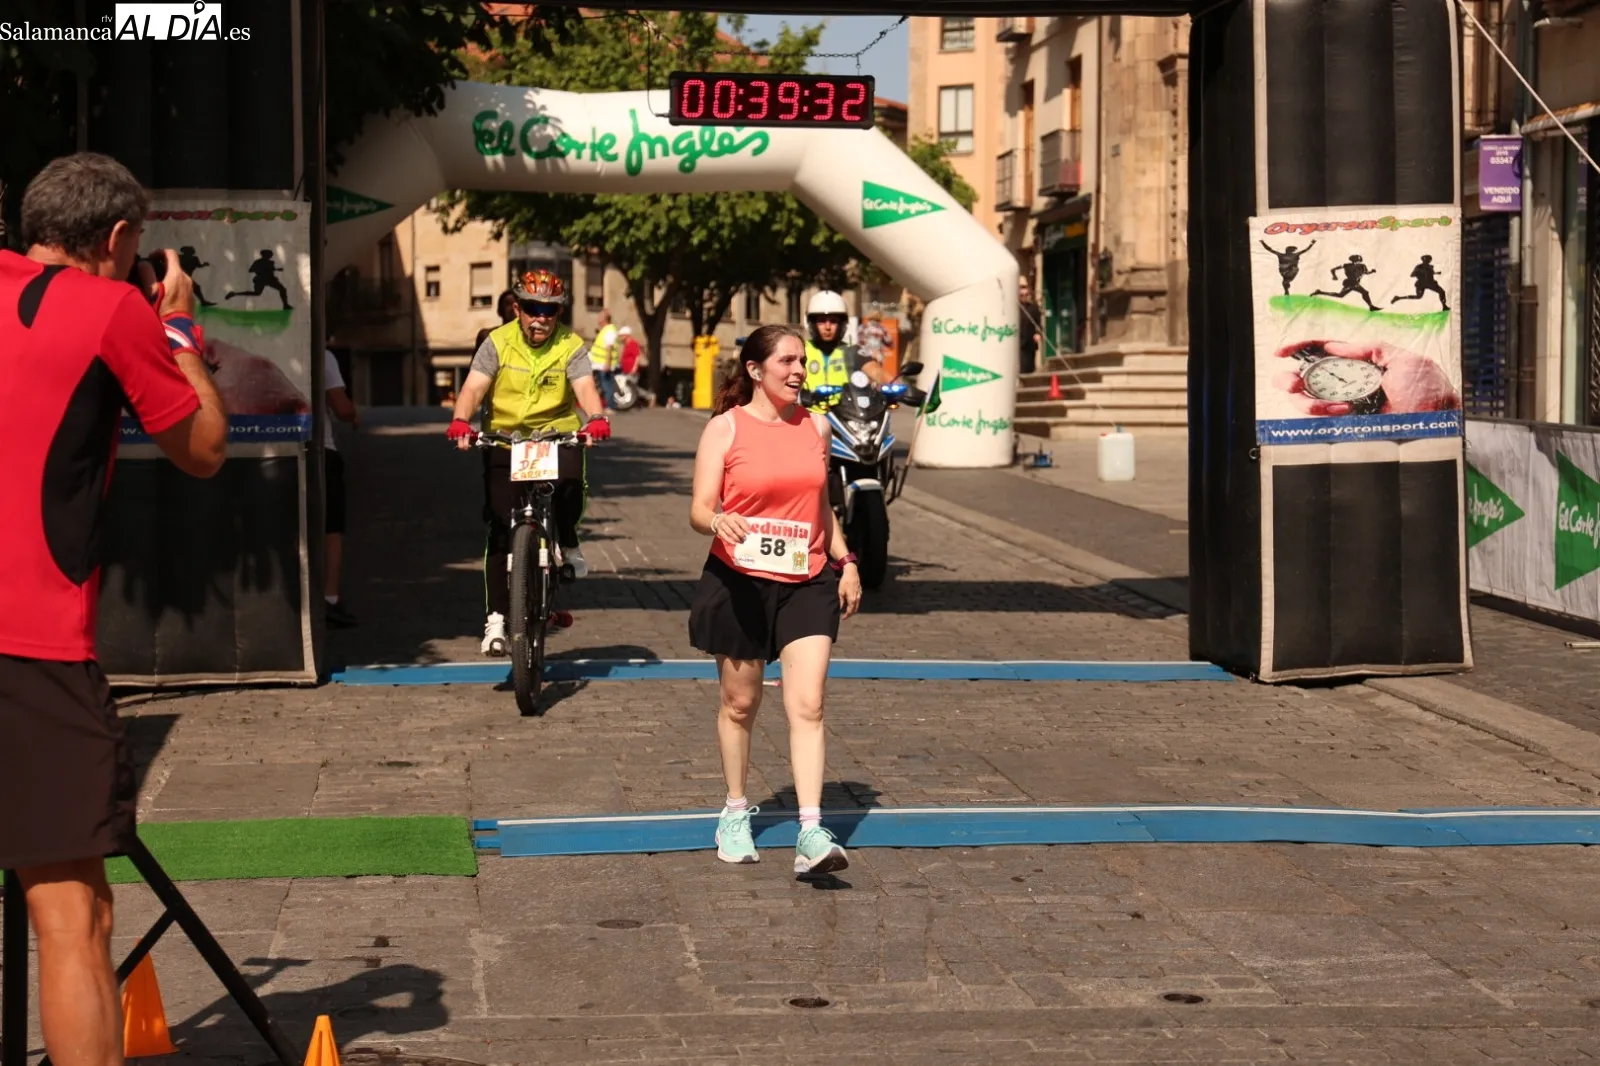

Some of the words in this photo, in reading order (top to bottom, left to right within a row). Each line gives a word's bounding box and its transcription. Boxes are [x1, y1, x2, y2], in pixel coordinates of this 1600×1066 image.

[681, 79, 866, 121] 00:39:32
[472, 110, 516, 157] El
[519, 114, 618, 162] Corte
[1271, 420, 1459, 437] www.orycronsport.com
[519, 459, 539, 471] DE
[1558, 501, 1569, 531] El
[1569, 505, 1594, 538] Corte
[748, 522, 809, 539] edunia
[760, 537, 786, 556] 58
